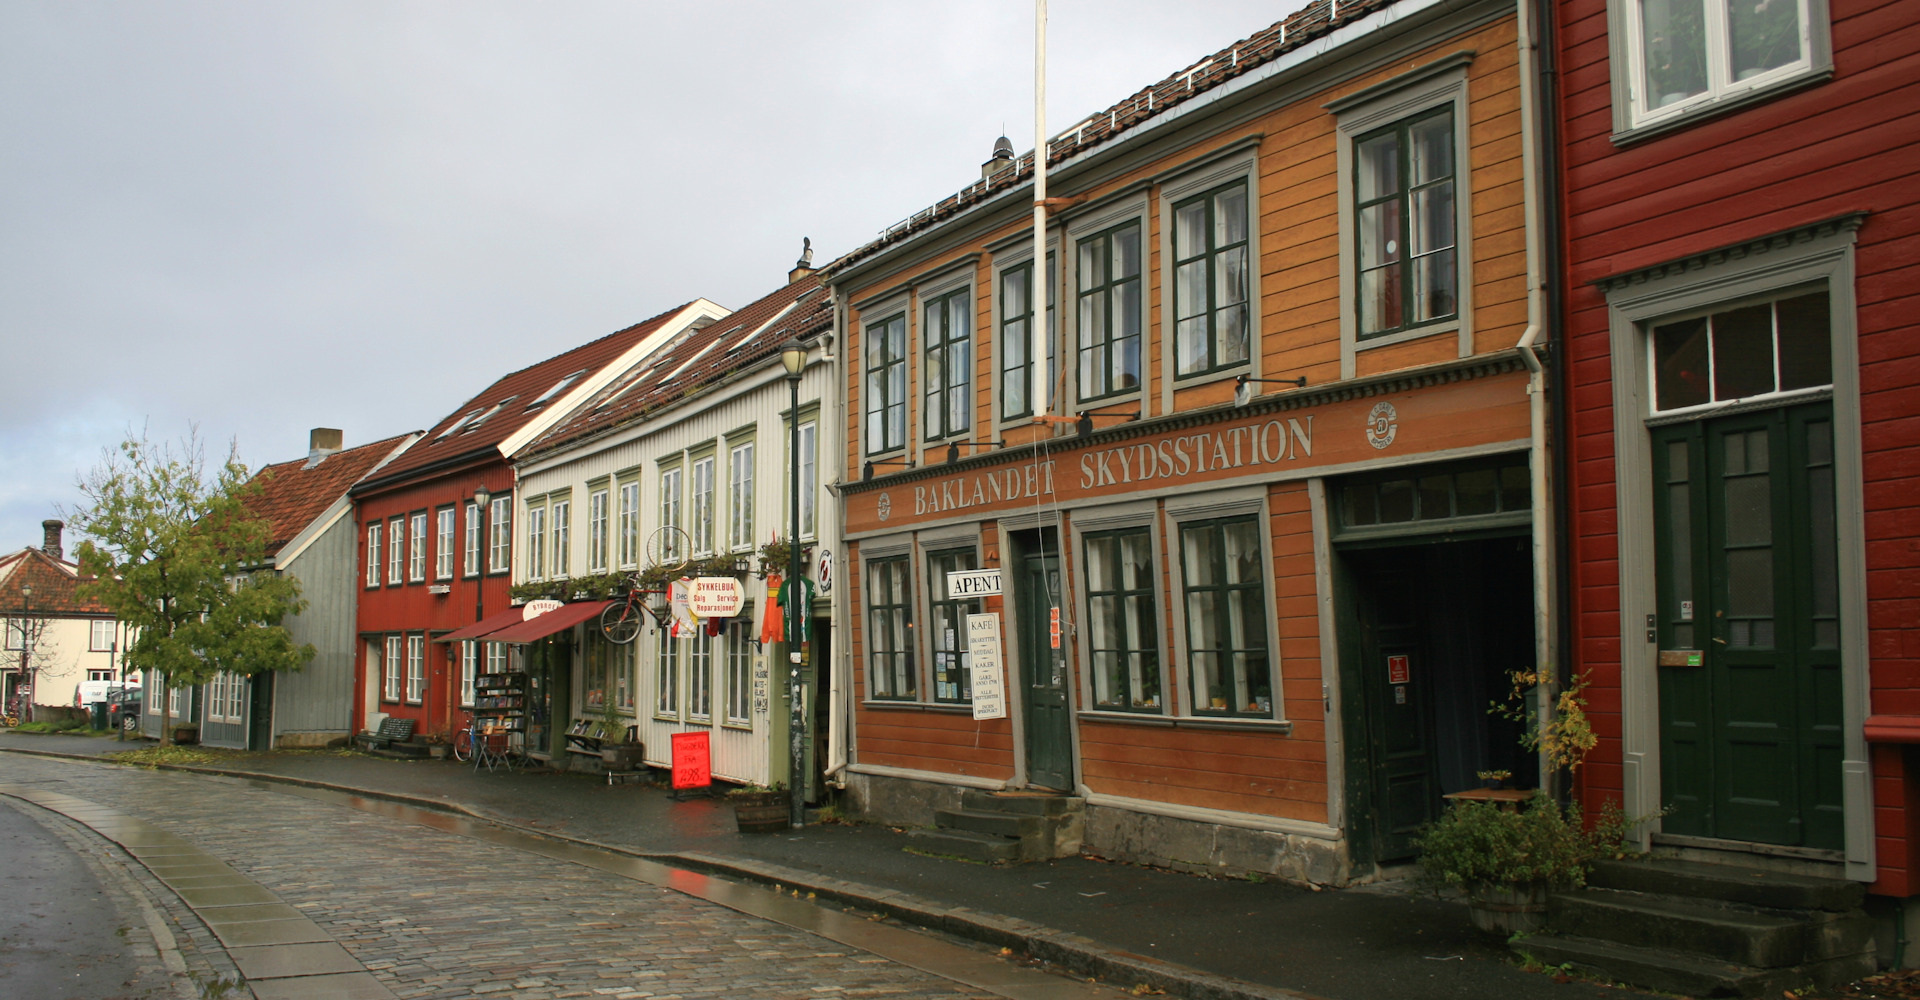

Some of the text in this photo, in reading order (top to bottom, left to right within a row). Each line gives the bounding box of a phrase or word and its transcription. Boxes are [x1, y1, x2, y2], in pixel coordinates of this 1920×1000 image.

[914, 460, 1056, 516] BAKLANDET
[1080, 415, 1314, 490] SKYDSSTATION
[697, 582, 735, 591] SYKKELBUA
[953, 573, 1002, 594] ÅPENT
[693, 594, 706, 602] Salg
[971, 618, 993, 631] KAFÉ
[683, 755, 697, 764] FRA
